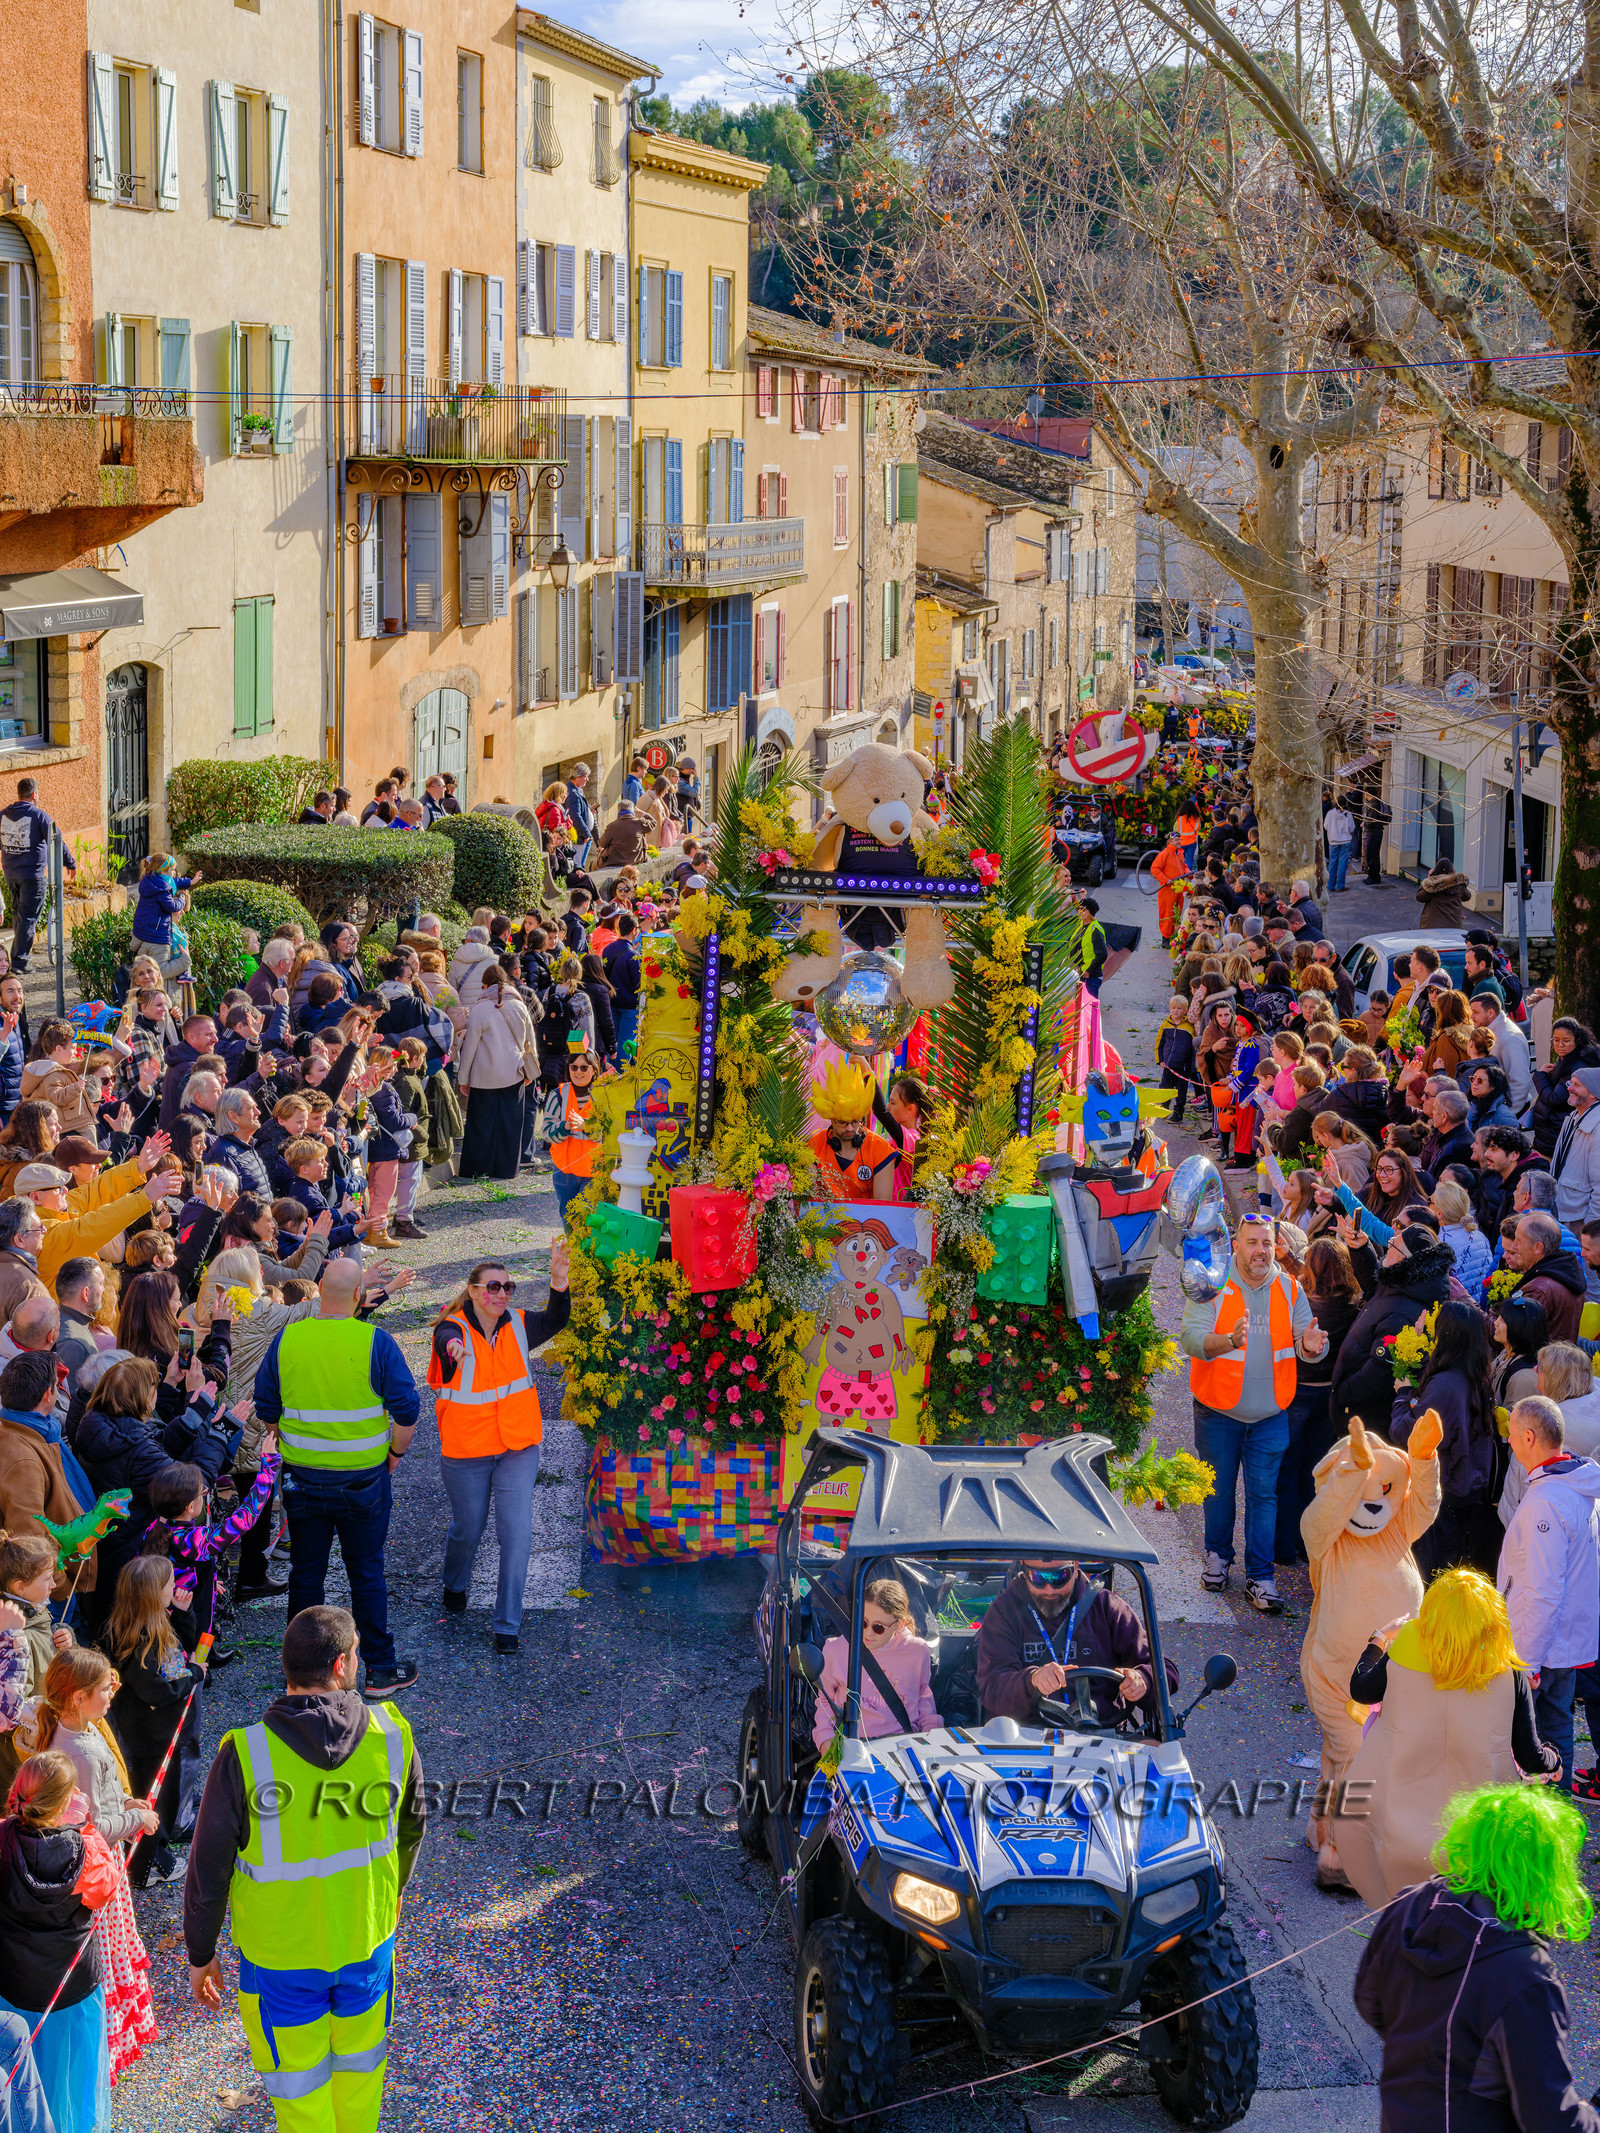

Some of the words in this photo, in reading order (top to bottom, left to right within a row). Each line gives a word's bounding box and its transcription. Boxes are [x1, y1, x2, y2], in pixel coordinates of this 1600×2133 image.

[85, 608, 91, 619] &
[92, 606, 110, 618] SONS
[651, 749, 663, 767] B
[1145, 825, 1153, 834] 4
[1000, 1816, 1077, 1826] POLARIS
[996, 1827, 1088, 1842] RZR
[1001, 1884, 1098, 1898] POLARIS
